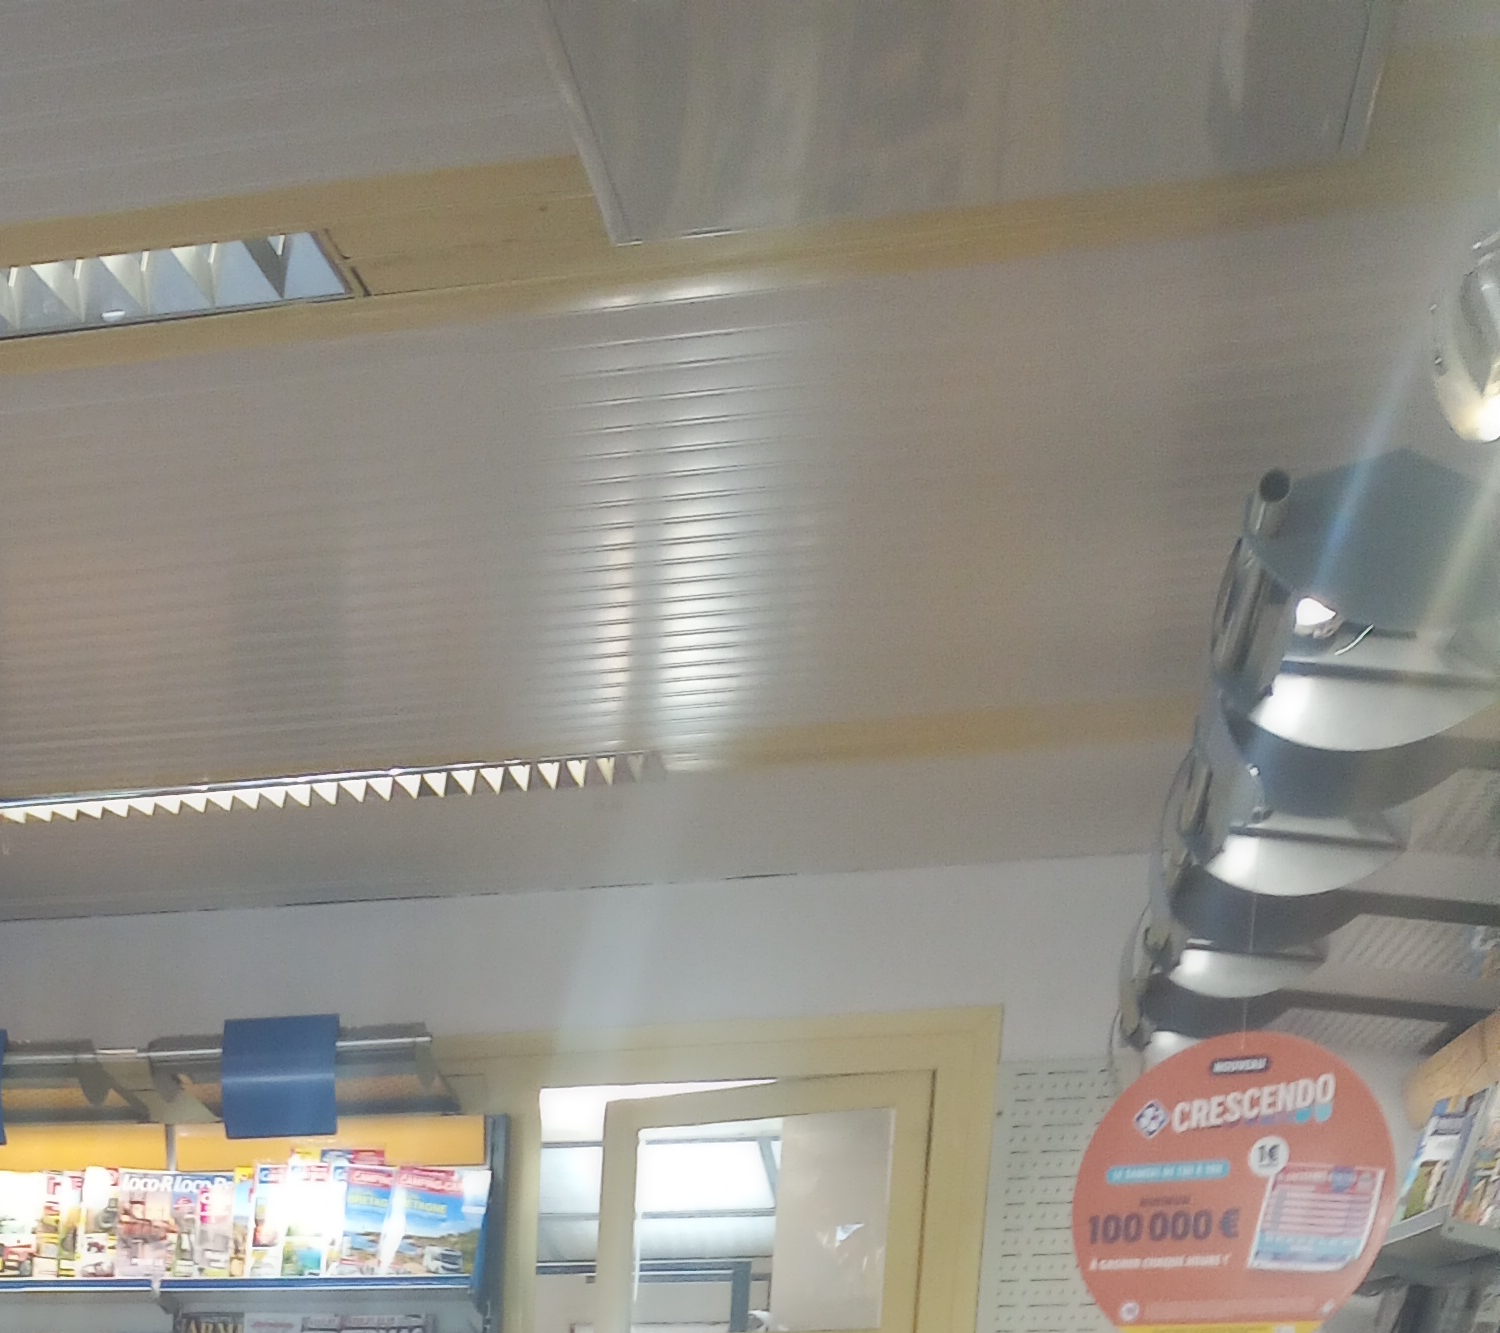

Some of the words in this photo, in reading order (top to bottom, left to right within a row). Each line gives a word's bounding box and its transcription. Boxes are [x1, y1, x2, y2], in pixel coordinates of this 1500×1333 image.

[1171, 1073, 1337, 1133] CRESCENDO
[1089, 1213, 1143, 1245] 100
[1149, 1210, 1213, 1242] 000
[1219, 1208, 1241, 1239] €
